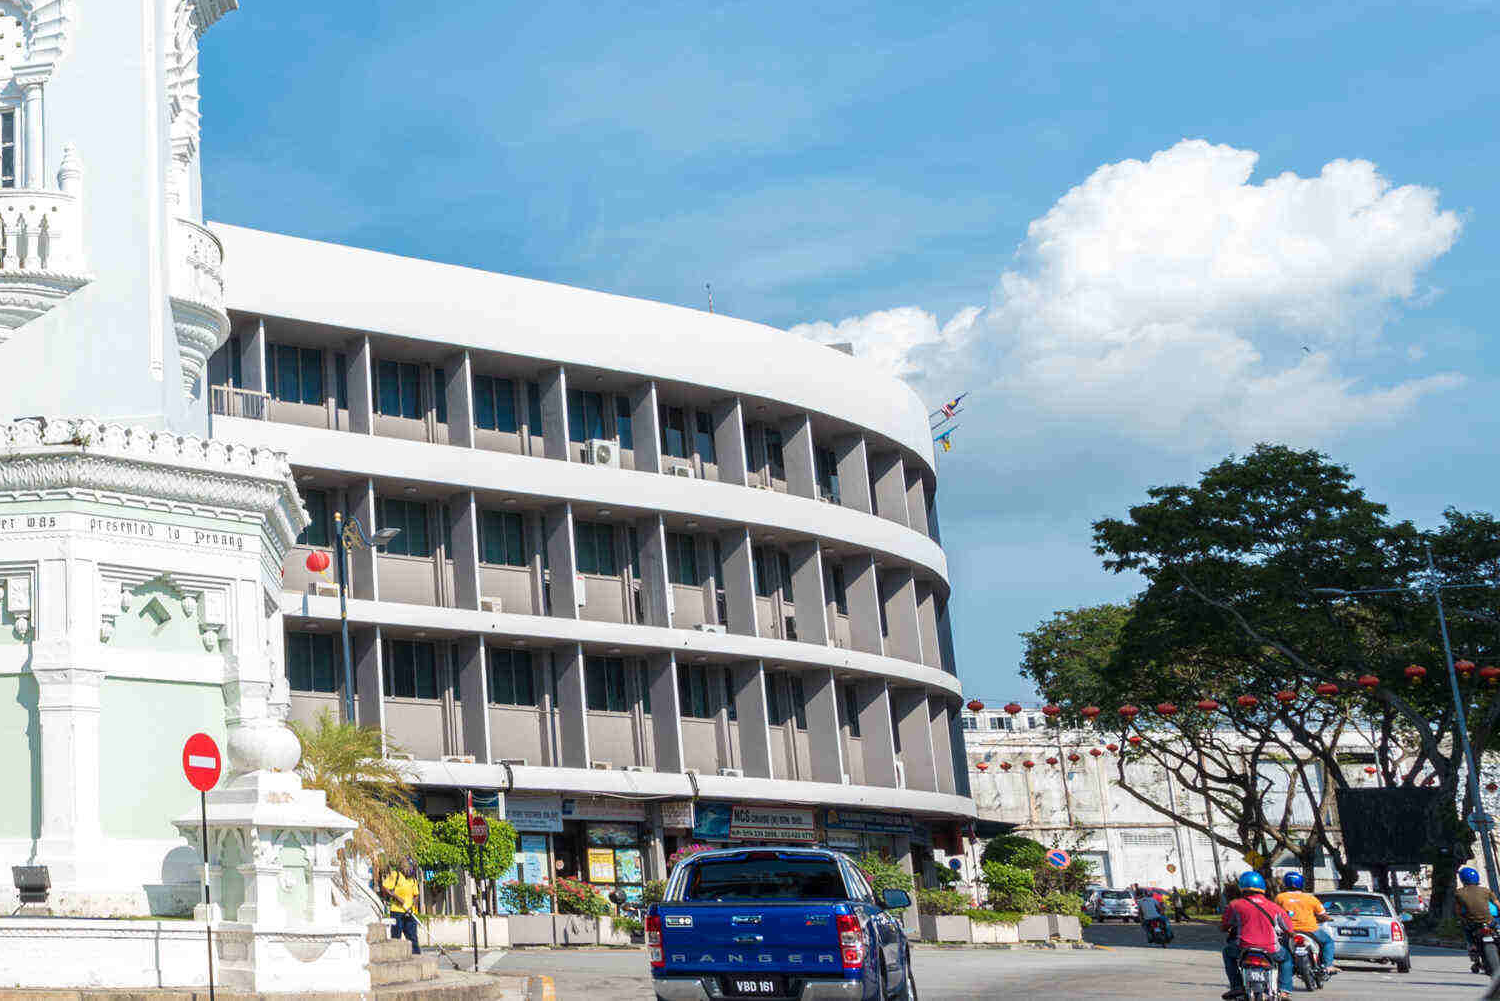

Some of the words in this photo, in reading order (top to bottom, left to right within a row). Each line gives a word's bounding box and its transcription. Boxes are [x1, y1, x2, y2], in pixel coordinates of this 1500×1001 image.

[27, 516, 56, 528] was
[90, 518, 155, 537] presented
[168, 526, 180, 540] to
[672, 954, 835, 963] RANGER
[736, 981, 757, 992] VBD
[759, 981, 774, 992] 161
